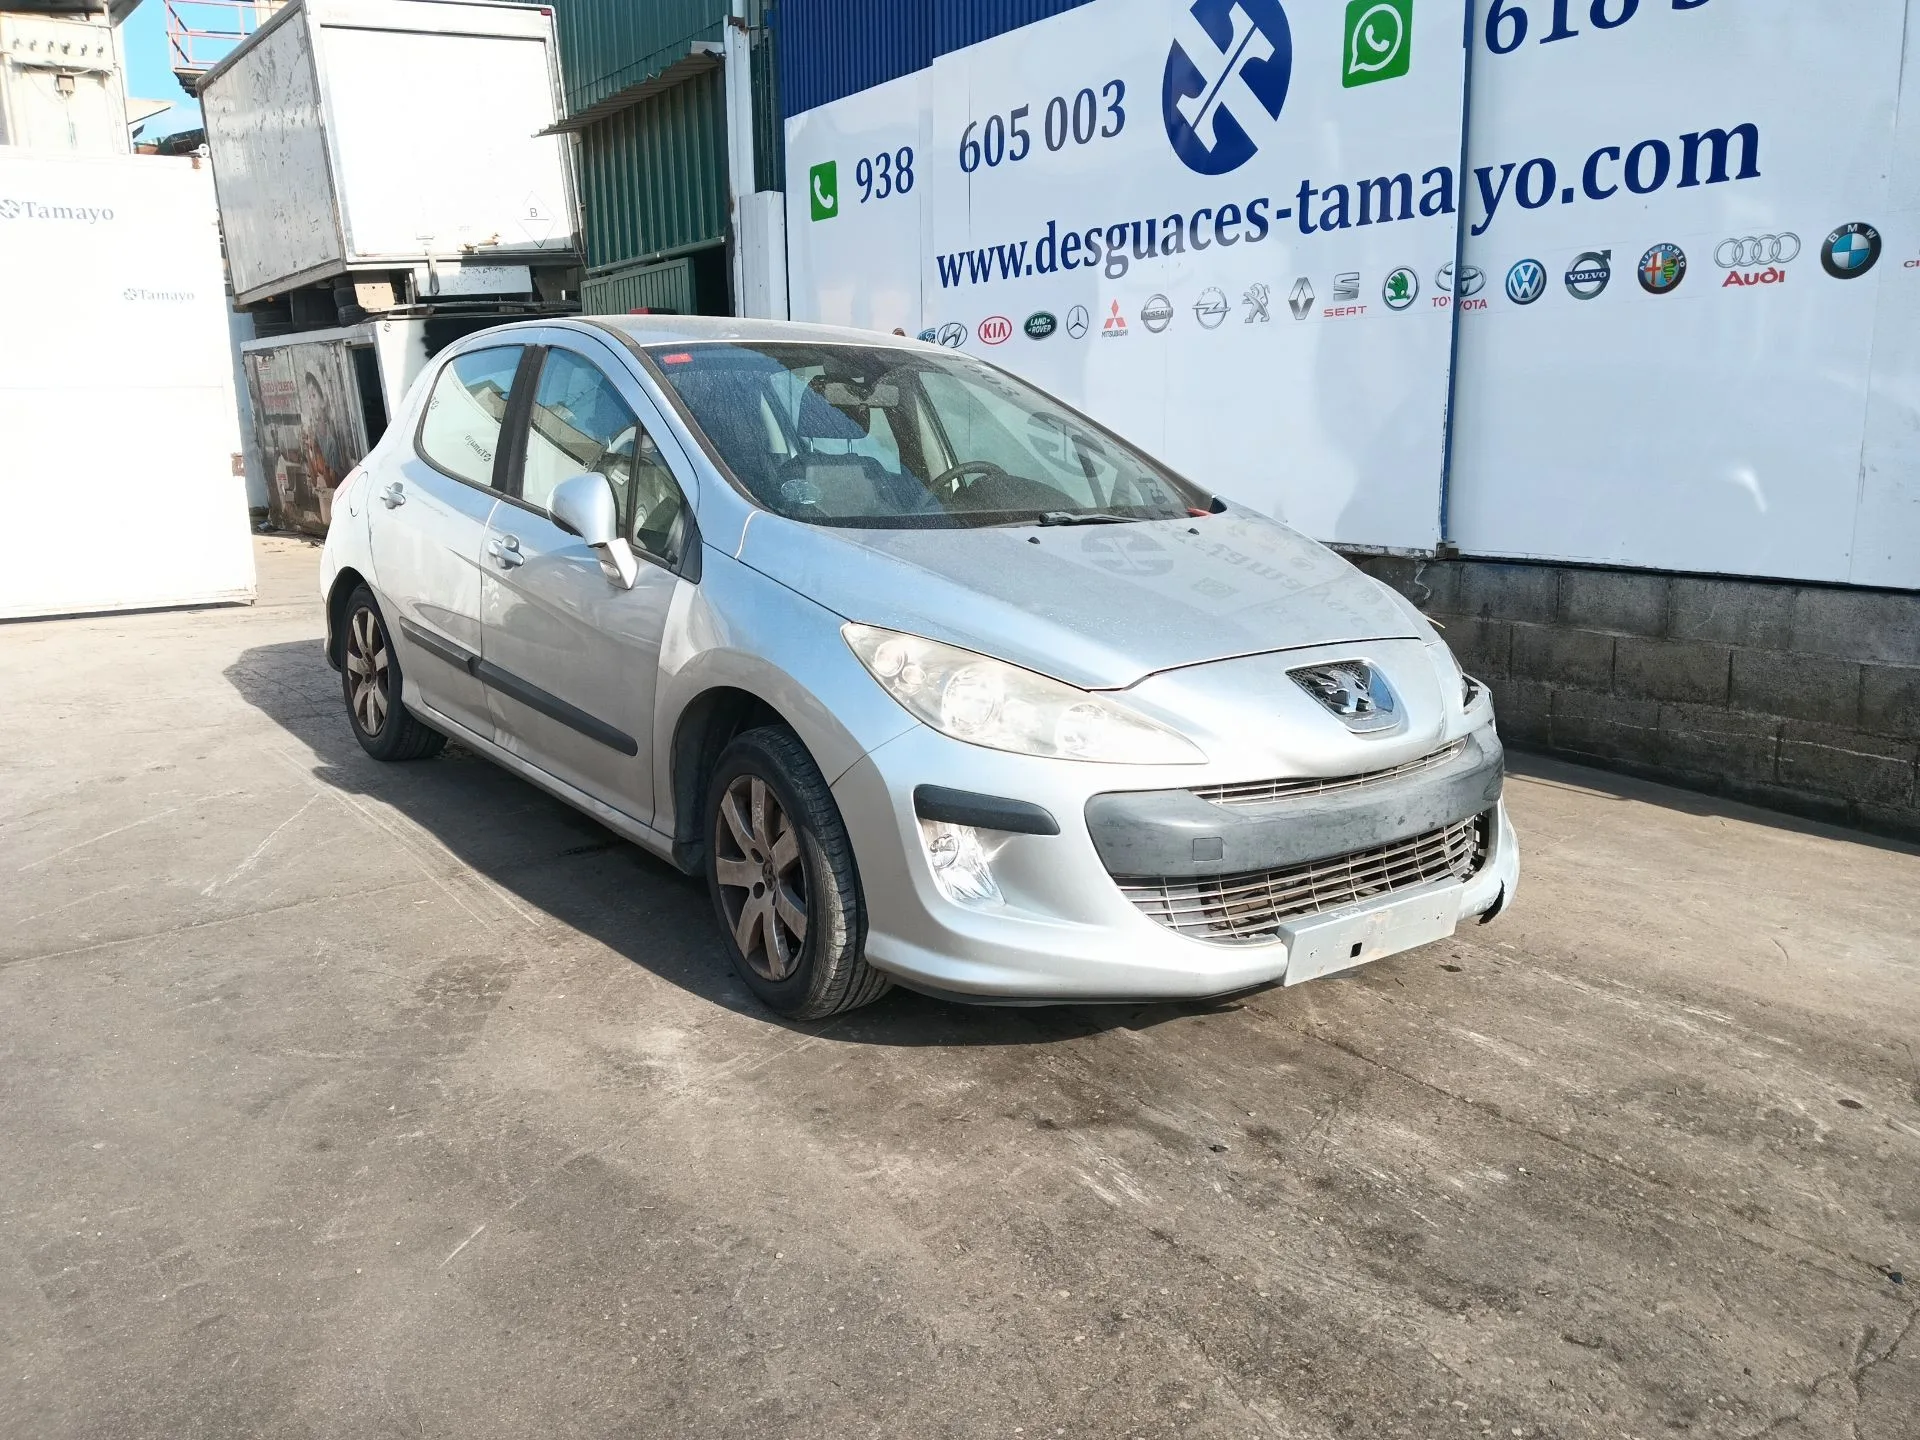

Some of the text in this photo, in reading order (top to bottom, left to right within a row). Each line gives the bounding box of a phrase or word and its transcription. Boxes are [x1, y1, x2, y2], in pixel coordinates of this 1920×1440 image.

[856, 79, 1126, 203] 938 605 003
[936, 122, 1761, 288] www.desguaces-tamayo.com
[22, 201, 114, 224] Tamayo
[530, 208, 537, 217] B
[1828, 224, 1876, 243] BMW
[1568, 271, 1607, 281] VOLVO
[138, 289, 195, 303] Tamayo
[1143, 309, 1171, 319] NISSAN
[1323, 305, 1367, 317] SEAT
[1030, 318, 1047, 327] LAND
[983, 323, 1007, 339] KIA
[1031, 325, 1051, 334] ROVER
[1101, 328, 1129, 338] MITSUBISHI
